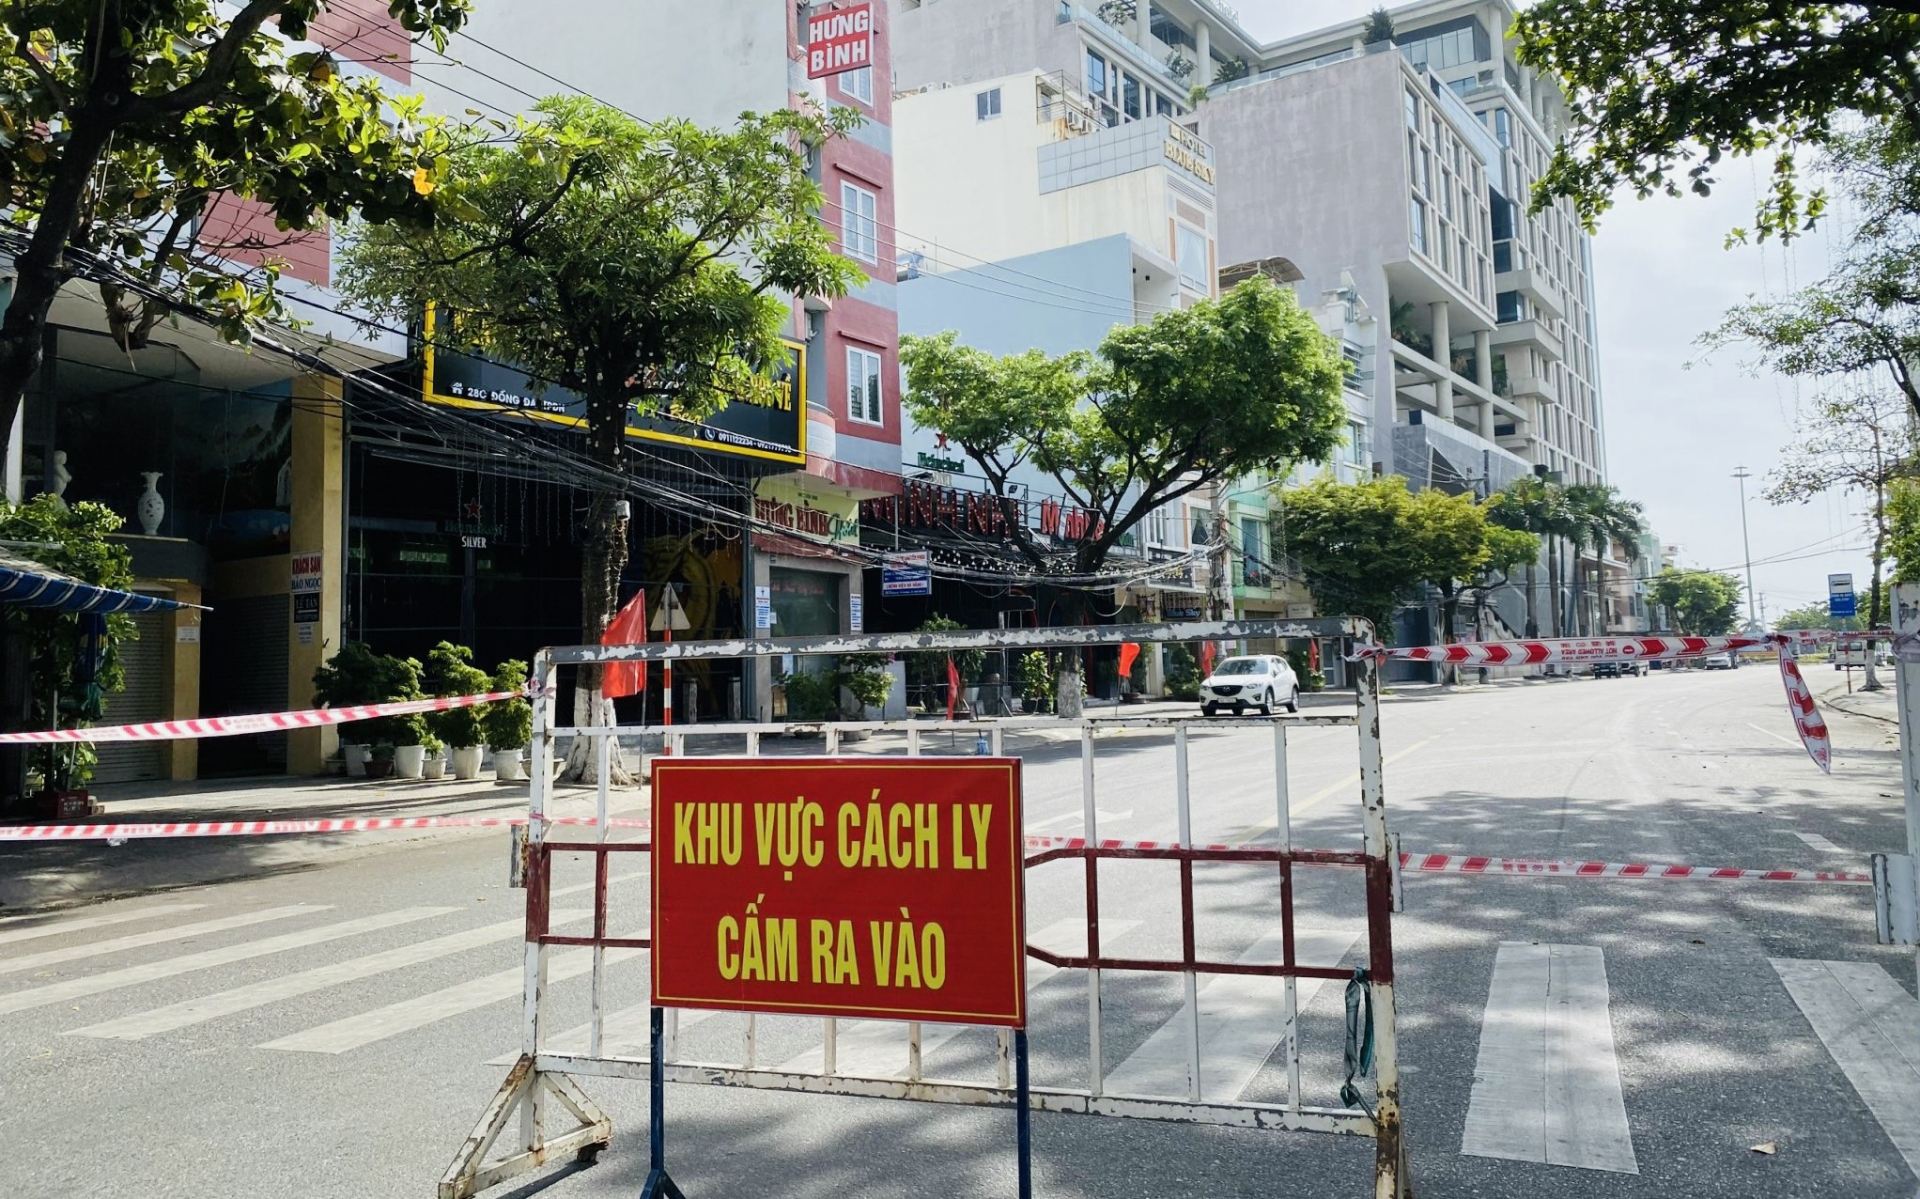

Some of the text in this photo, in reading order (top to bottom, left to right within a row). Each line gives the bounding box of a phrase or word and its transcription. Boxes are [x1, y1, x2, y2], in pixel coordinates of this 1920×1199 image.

[809, 10, 868, 44] HƯNG
[811, 39, 866, 72] BÌNH
[467, 387, 487, 399] 28C
[491, 389, 520, 405] ĐỐNG
[461, 535, 487, 549] SILVER
[674, 788, 993, 881] KHU VỰC CÁCH LY
[717, 893, 945, 989] CẤM RA VÀO
